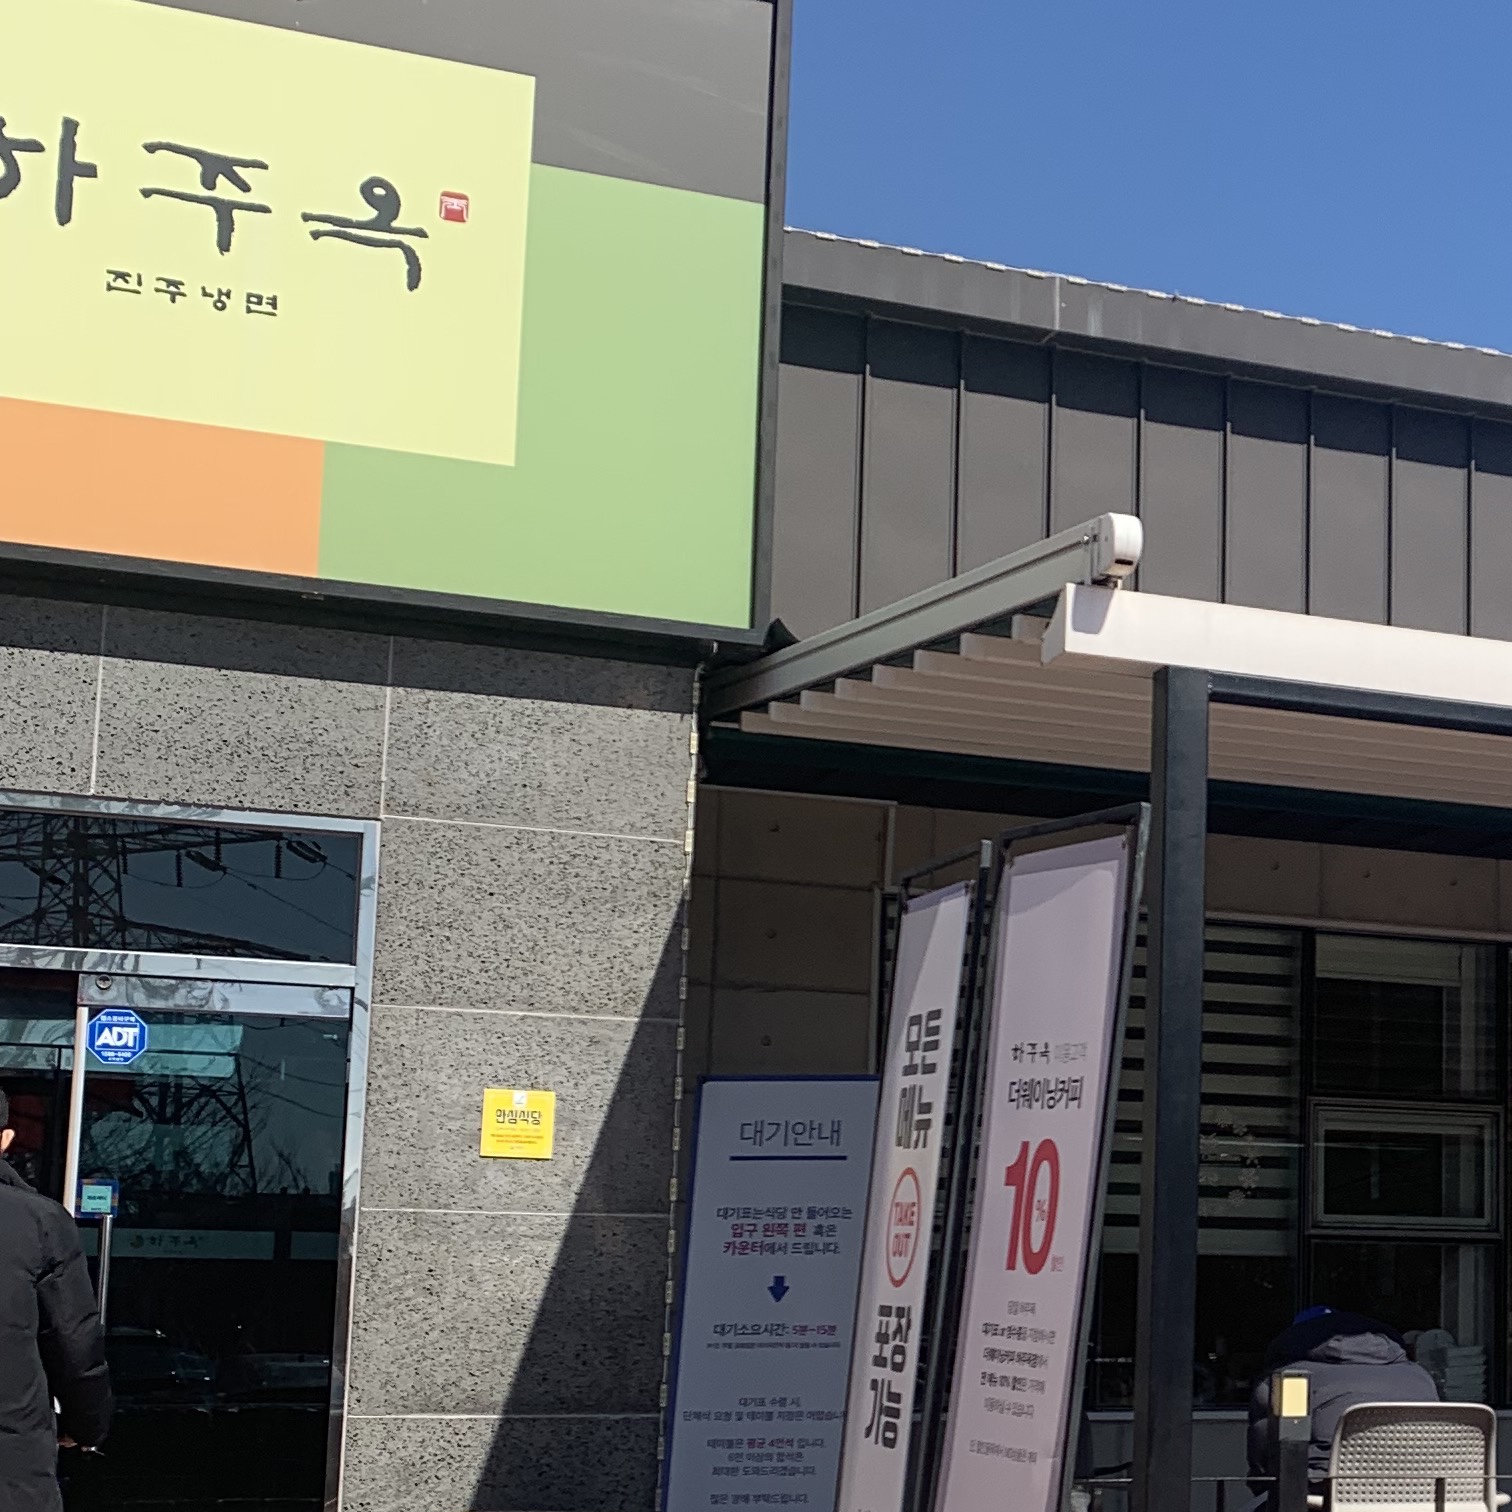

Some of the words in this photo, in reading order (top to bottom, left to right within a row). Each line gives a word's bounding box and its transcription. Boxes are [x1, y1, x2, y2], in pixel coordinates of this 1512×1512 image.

[105, 268, 278, 317] 진주냉면
[95, 1026, 139, 1047] ADT
[902, 1008, 943, 1077] 모든
[1010, 1042, 1050, 1064] 하주옥
[495, 1108, 542, 1126] 안심식당
[740, 1119, 841, 1147] 대기안내
[895, 1083, 932, 1150] 메뉴
[730, 1223, 758, 1238] 입구
[872, 1304, 912, 1374] 포장
[864, 1378, 903, 1450] 가능
